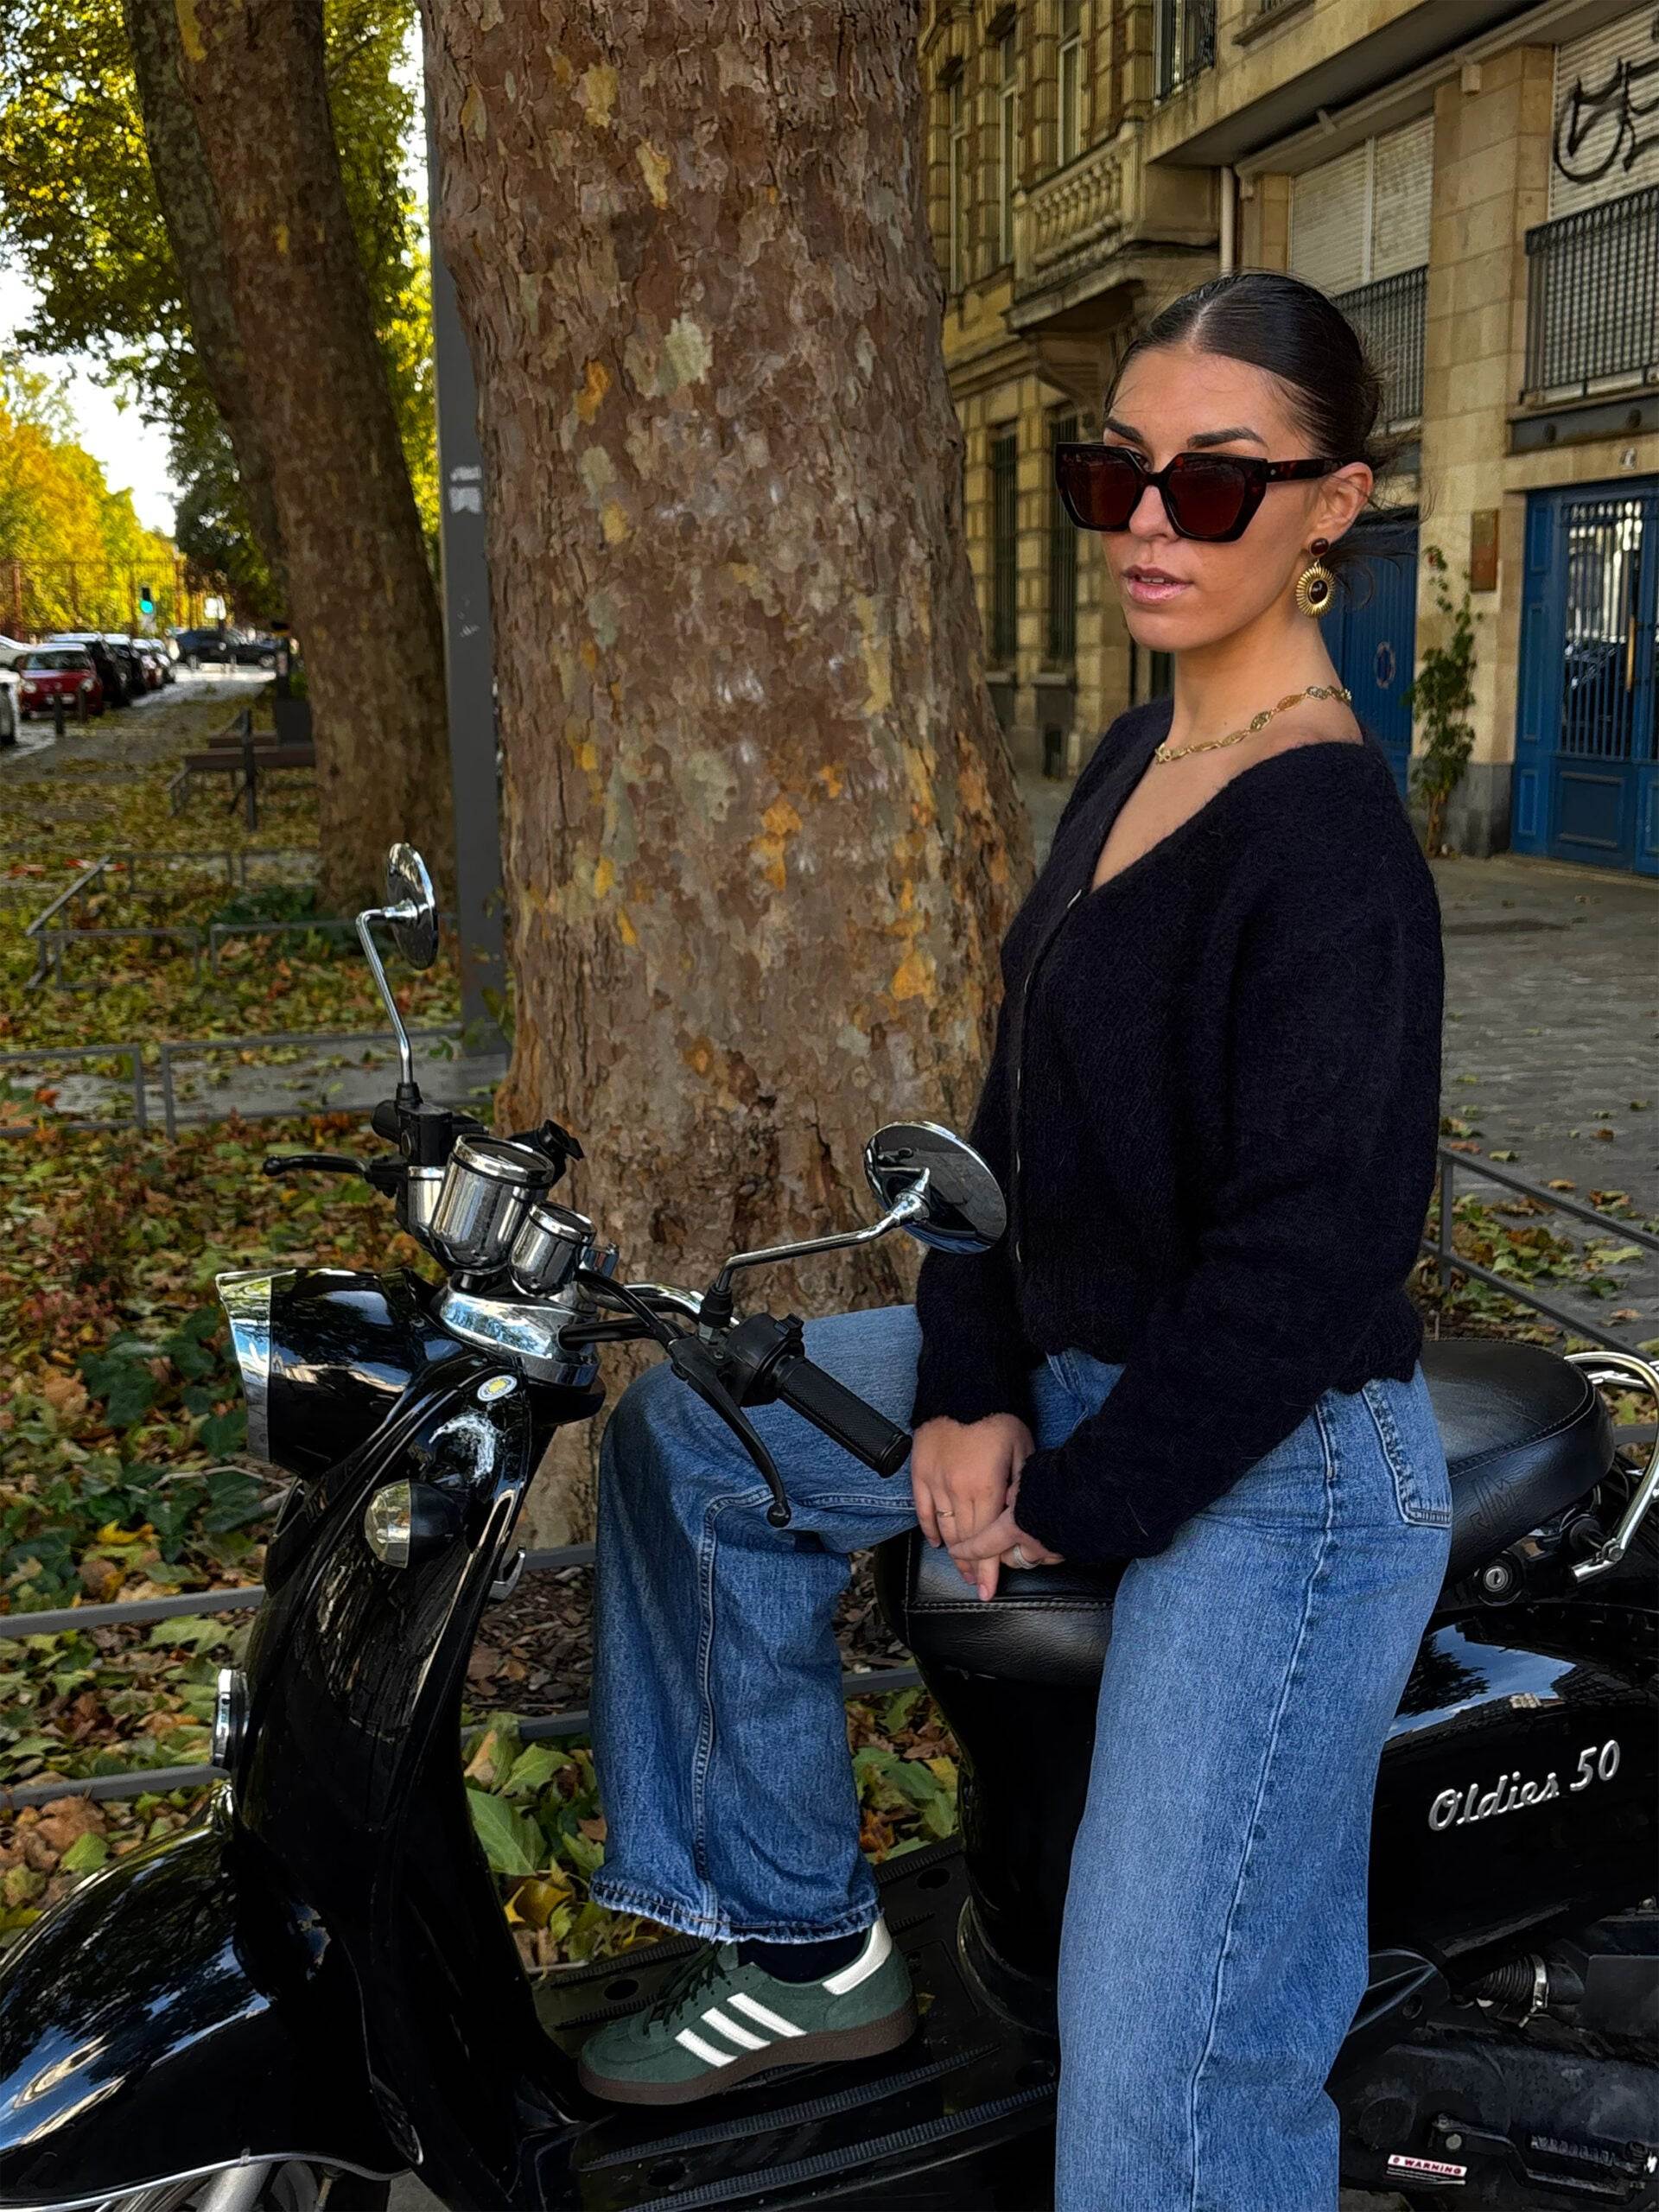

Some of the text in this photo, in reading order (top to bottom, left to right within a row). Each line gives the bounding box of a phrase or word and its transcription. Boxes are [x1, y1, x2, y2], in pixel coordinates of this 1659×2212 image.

[1428, 1739, 1620, 1831] Oldies 50
[1405, 2158, 1461, 2175] WARNING
